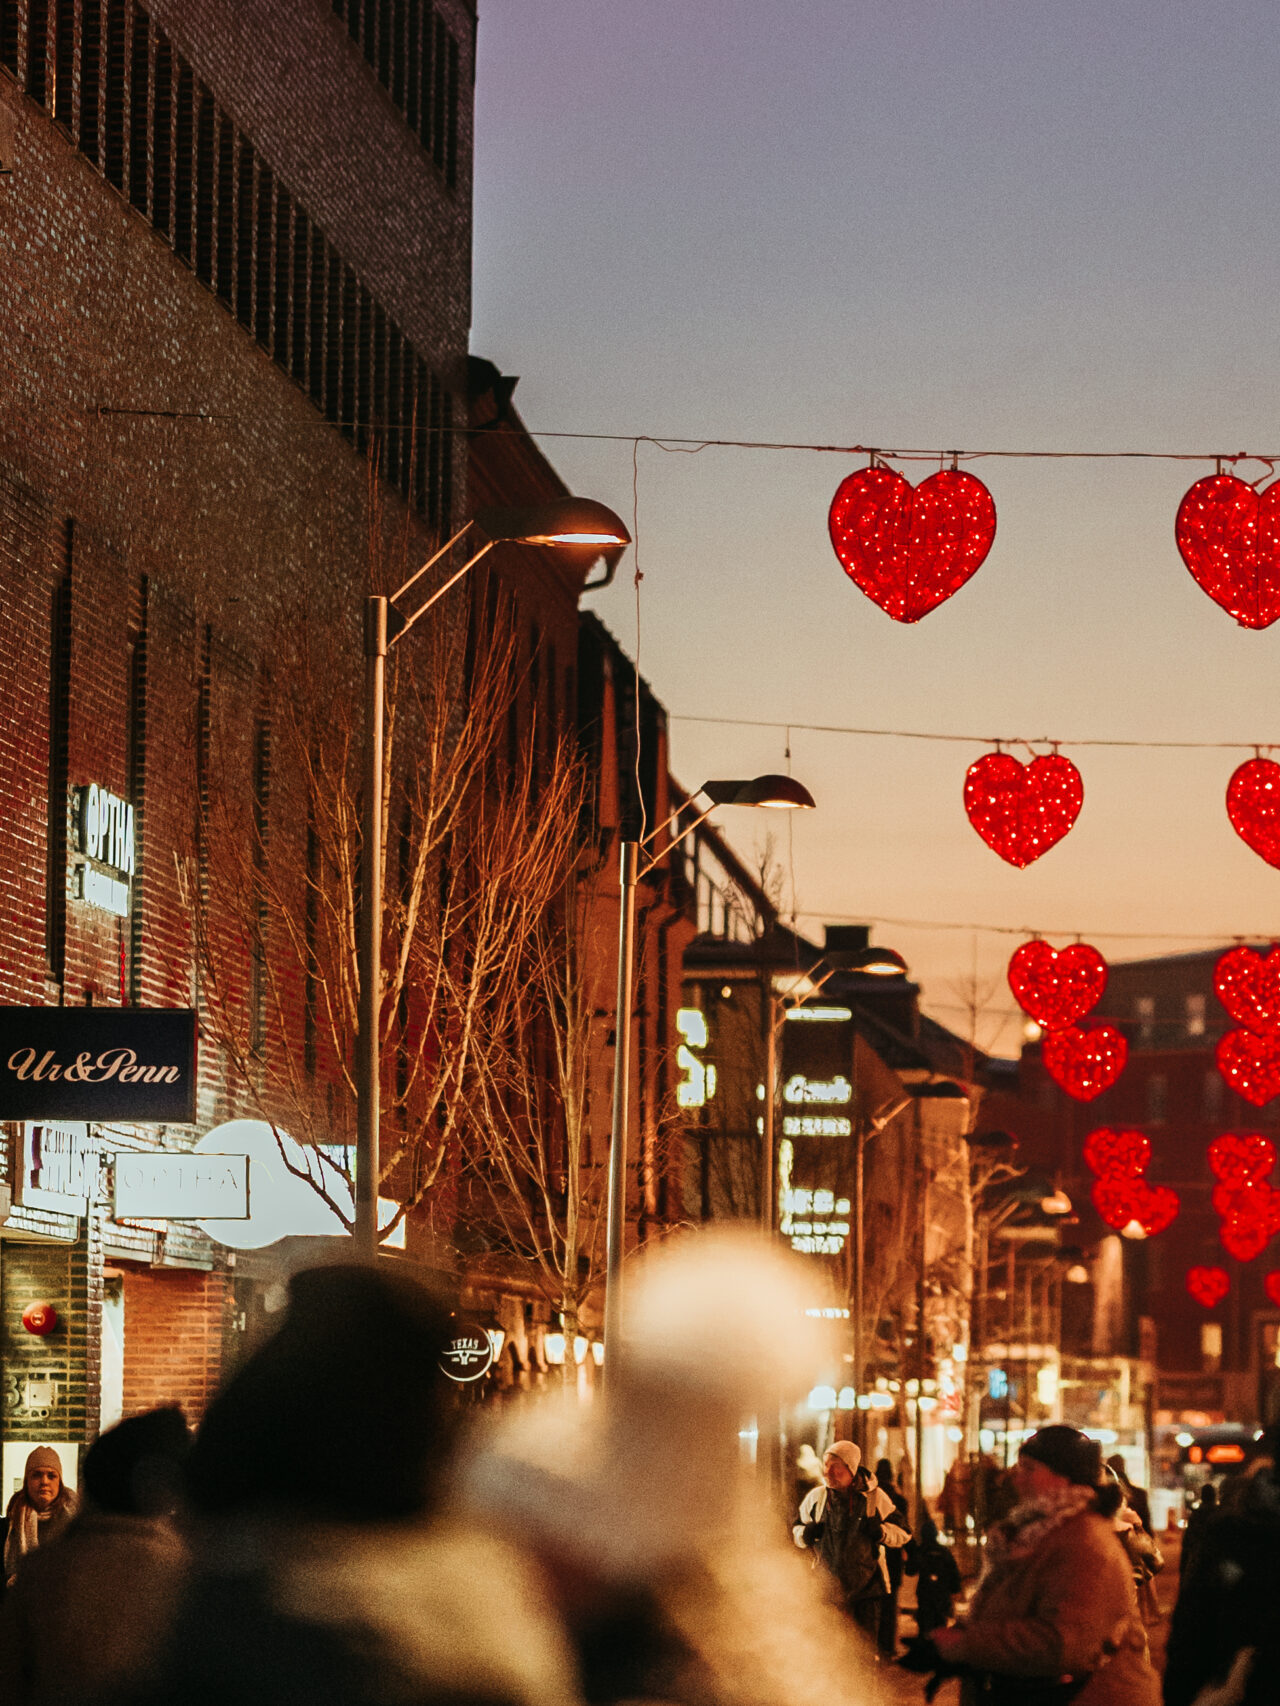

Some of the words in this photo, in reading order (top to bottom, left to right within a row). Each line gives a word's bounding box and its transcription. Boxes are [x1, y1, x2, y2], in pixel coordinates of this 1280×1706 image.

[86, 782, 135, 877] OPTHA
[7, 1047, 181, 1084] Ur&Penn
[451, 1337, 479, 1350] TEXAS
